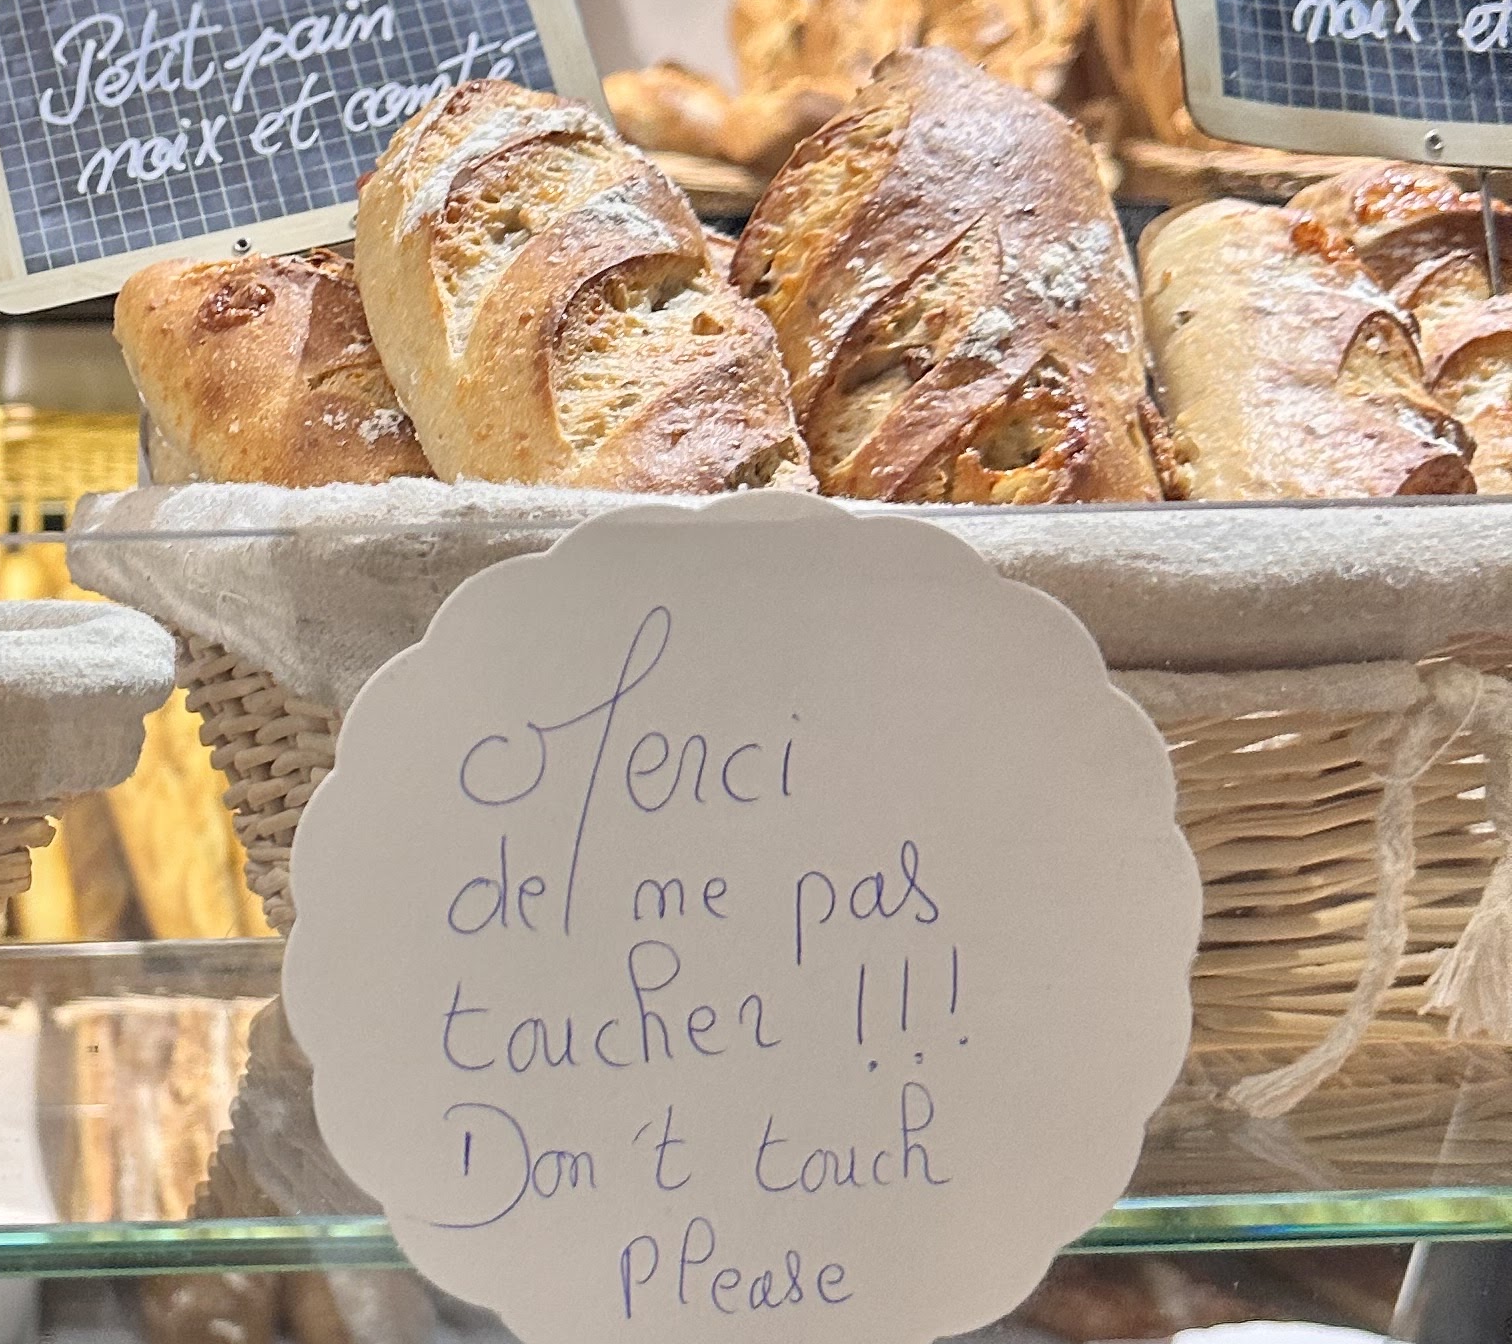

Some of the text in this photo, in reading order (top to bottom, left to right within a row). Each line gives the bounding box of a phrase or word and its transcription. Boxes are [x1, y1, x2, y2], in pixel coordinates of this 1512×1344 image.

[39, 1, 224, 127] Petit
[77, 114, 228, 195] noix
[249, 71, 337, 156] et
[459, 605, 802, 937] Merci
[795, 839, 941, 967] pas
[442, 939, 782, 1074] toucher
[754, 1081, 952, 1194] touch
